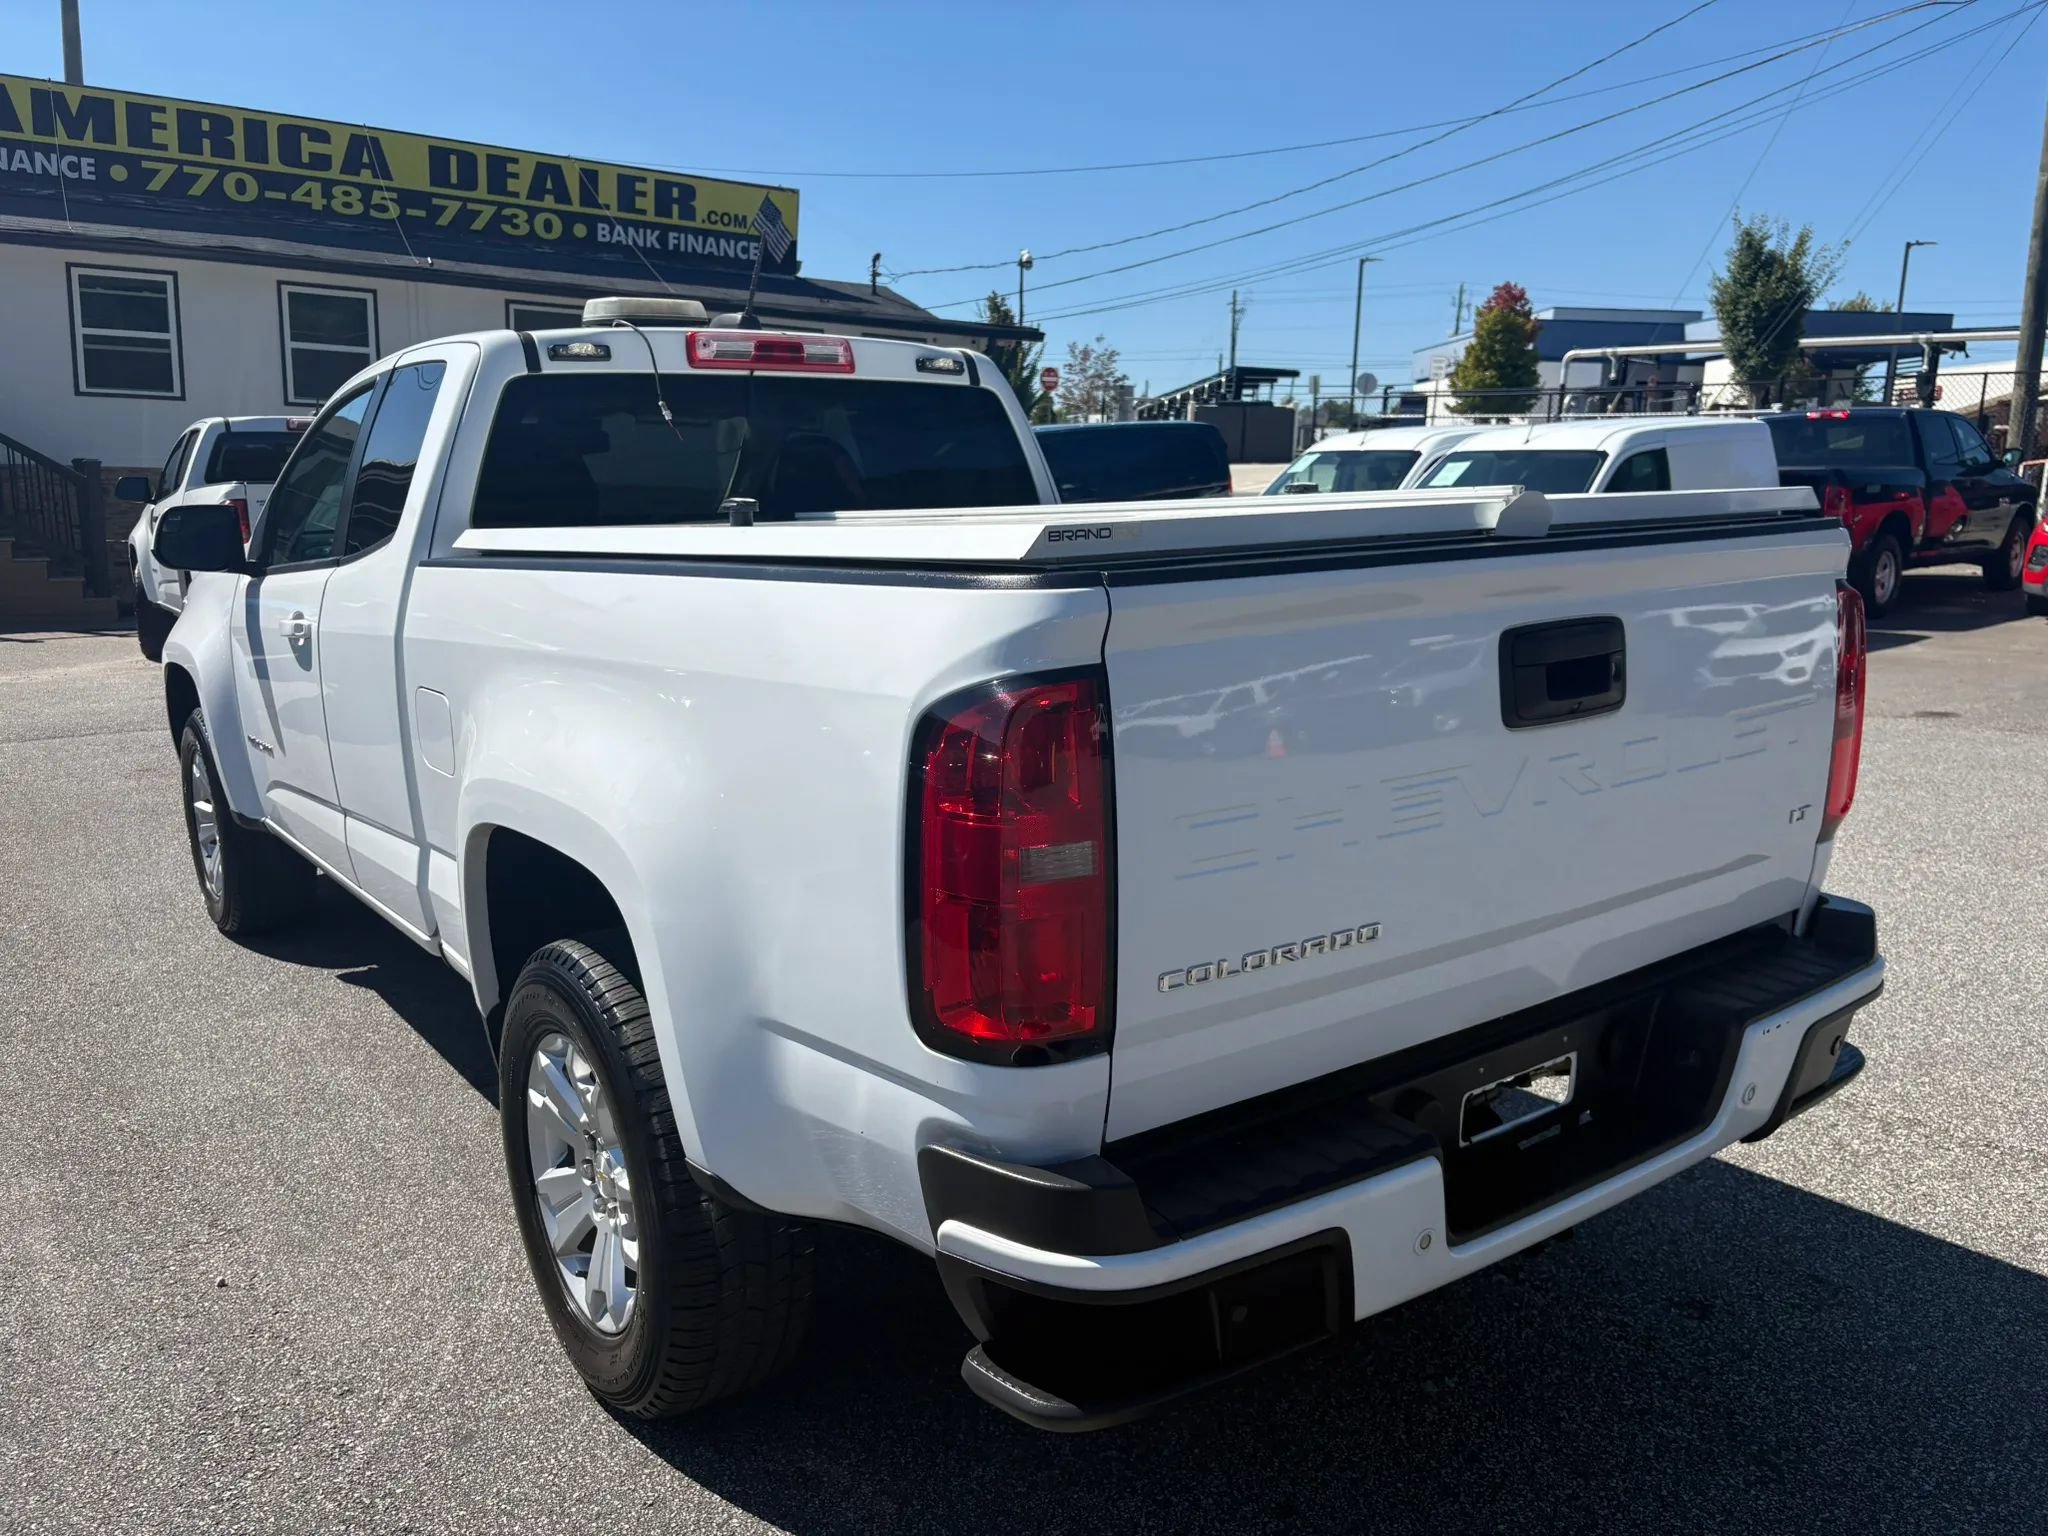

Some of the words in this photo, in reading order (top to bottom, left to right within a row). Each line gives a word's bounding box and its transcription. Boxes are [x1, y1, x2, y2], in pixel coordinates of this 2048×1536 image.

[140, 160, 563, 241] 770-485-7730
[597, 223, 662, 249] BANK
[668, 231, 761, 261] FINANCE
[1047, 527, 1112, 543] BRAND
[1158, 921, 1383, 993] COLORADO
